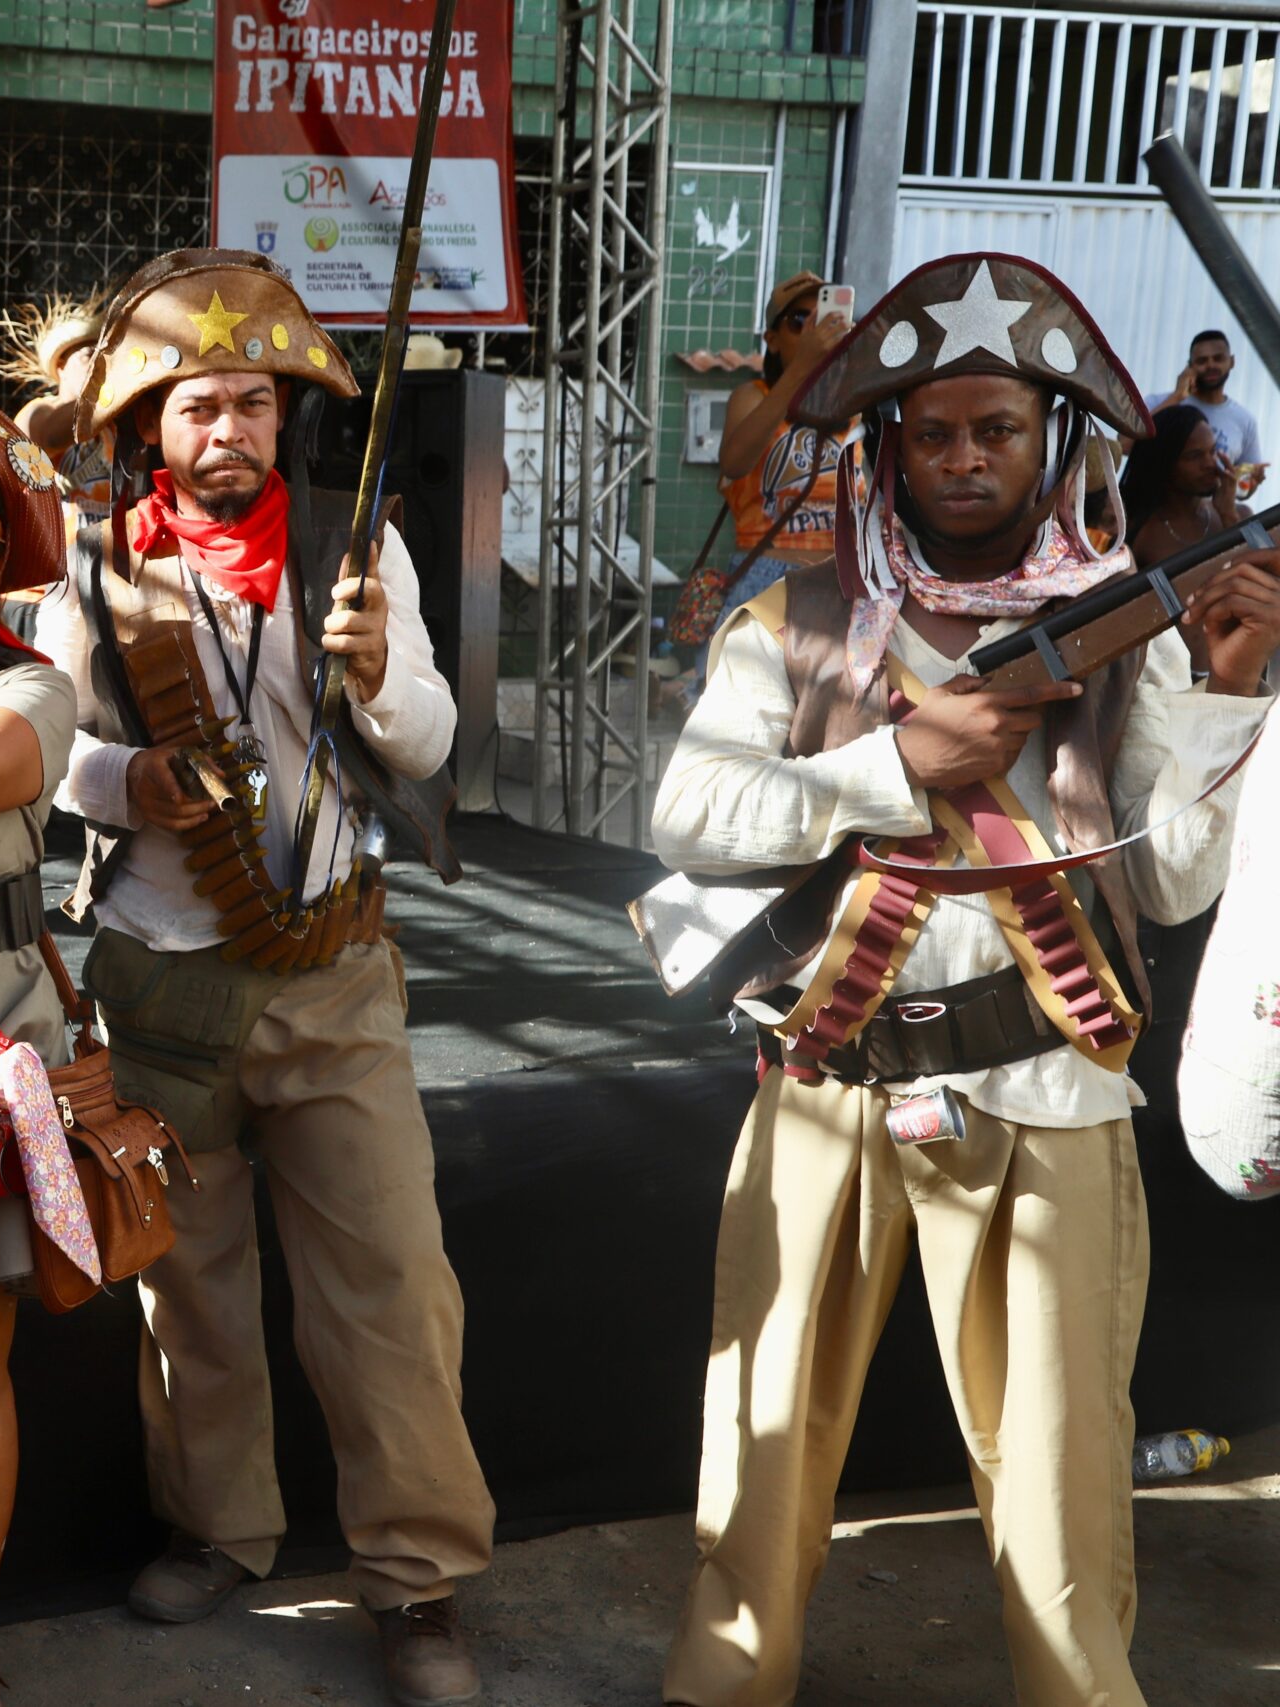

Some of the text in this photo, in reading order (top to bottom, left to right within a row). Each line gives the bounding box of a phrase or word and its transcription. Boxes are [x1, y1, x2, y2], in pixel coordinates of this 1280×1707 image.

[231, 15, 479, 60] Cangaceiros DE
[306, 262, 363, 271] SECRETARIA
[306, 272, 372, 281] MUNICIPAL DE
[306, 282, 392, 292] CULTURA E TURISM
